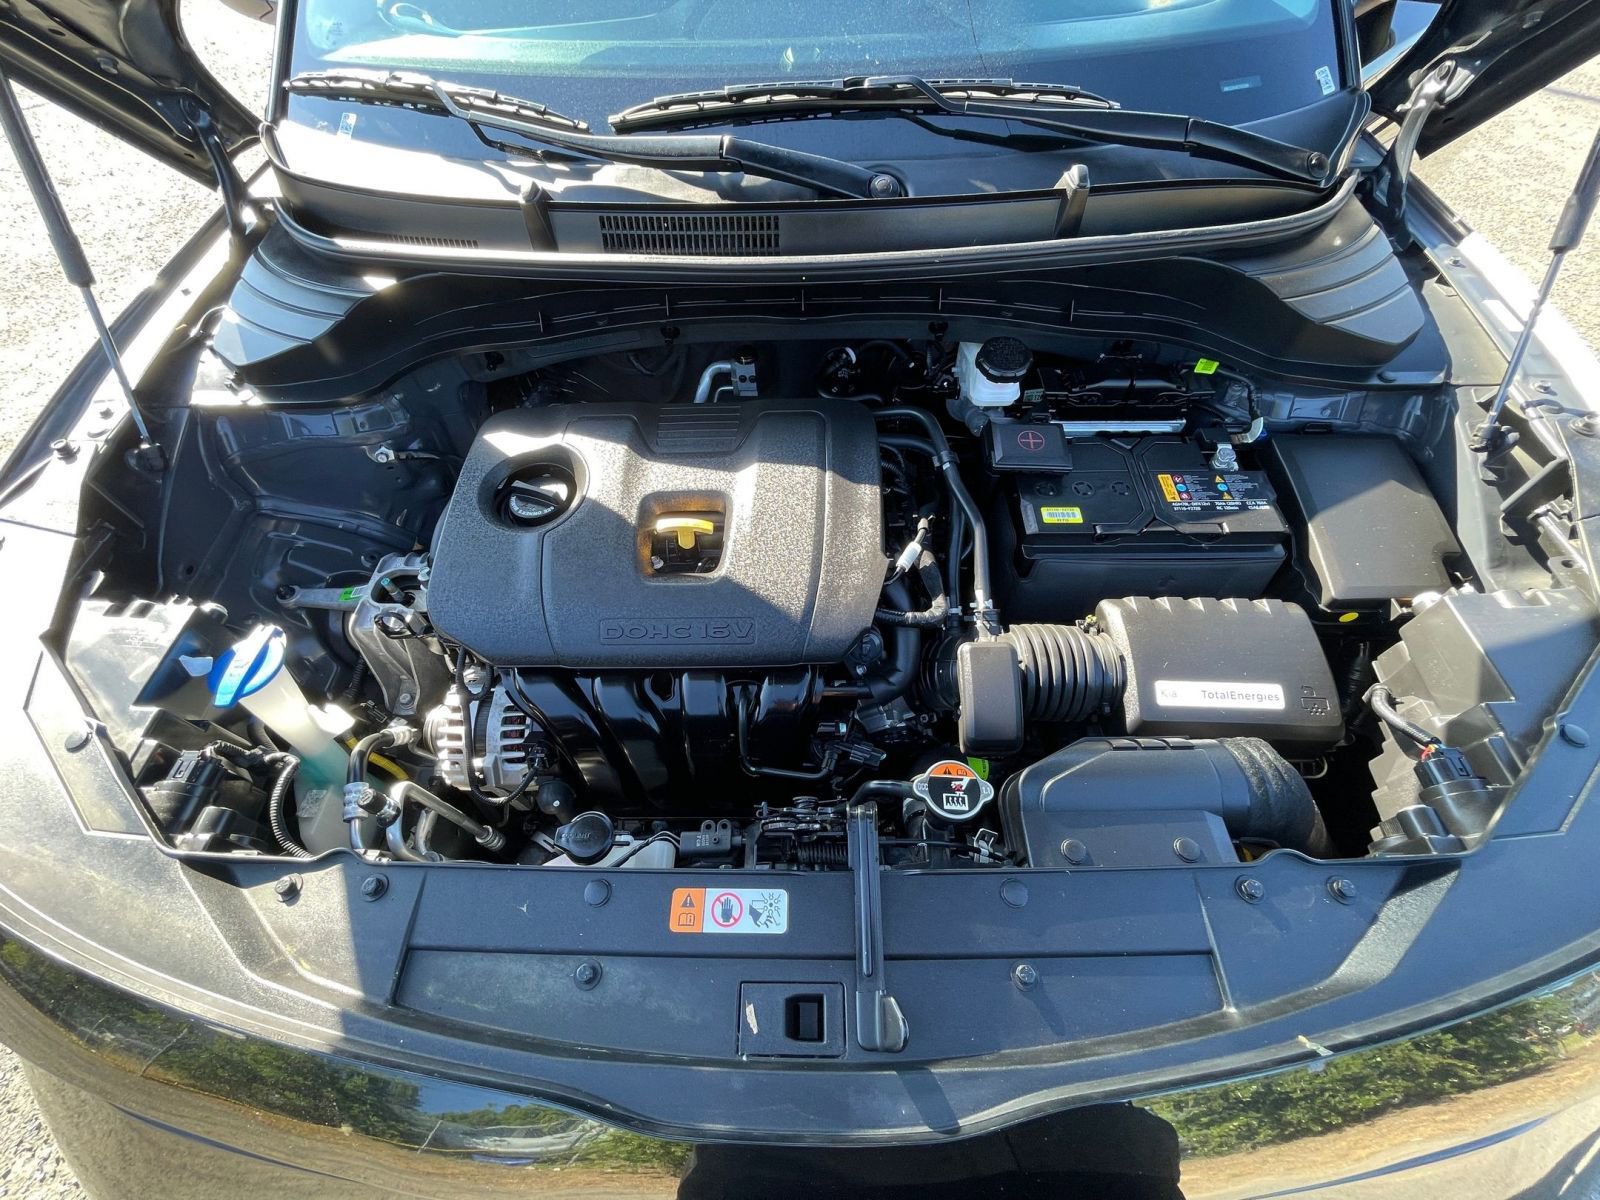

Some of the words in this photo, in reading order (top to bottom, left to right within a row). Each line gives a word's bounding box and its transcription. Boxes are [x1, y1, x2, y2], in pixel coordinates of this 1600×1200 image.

[602, 622, 692, 640] DOHC
[700, 622, 754, 640] 16V
[1201, 689, 1280, 703] TotalEnergies
